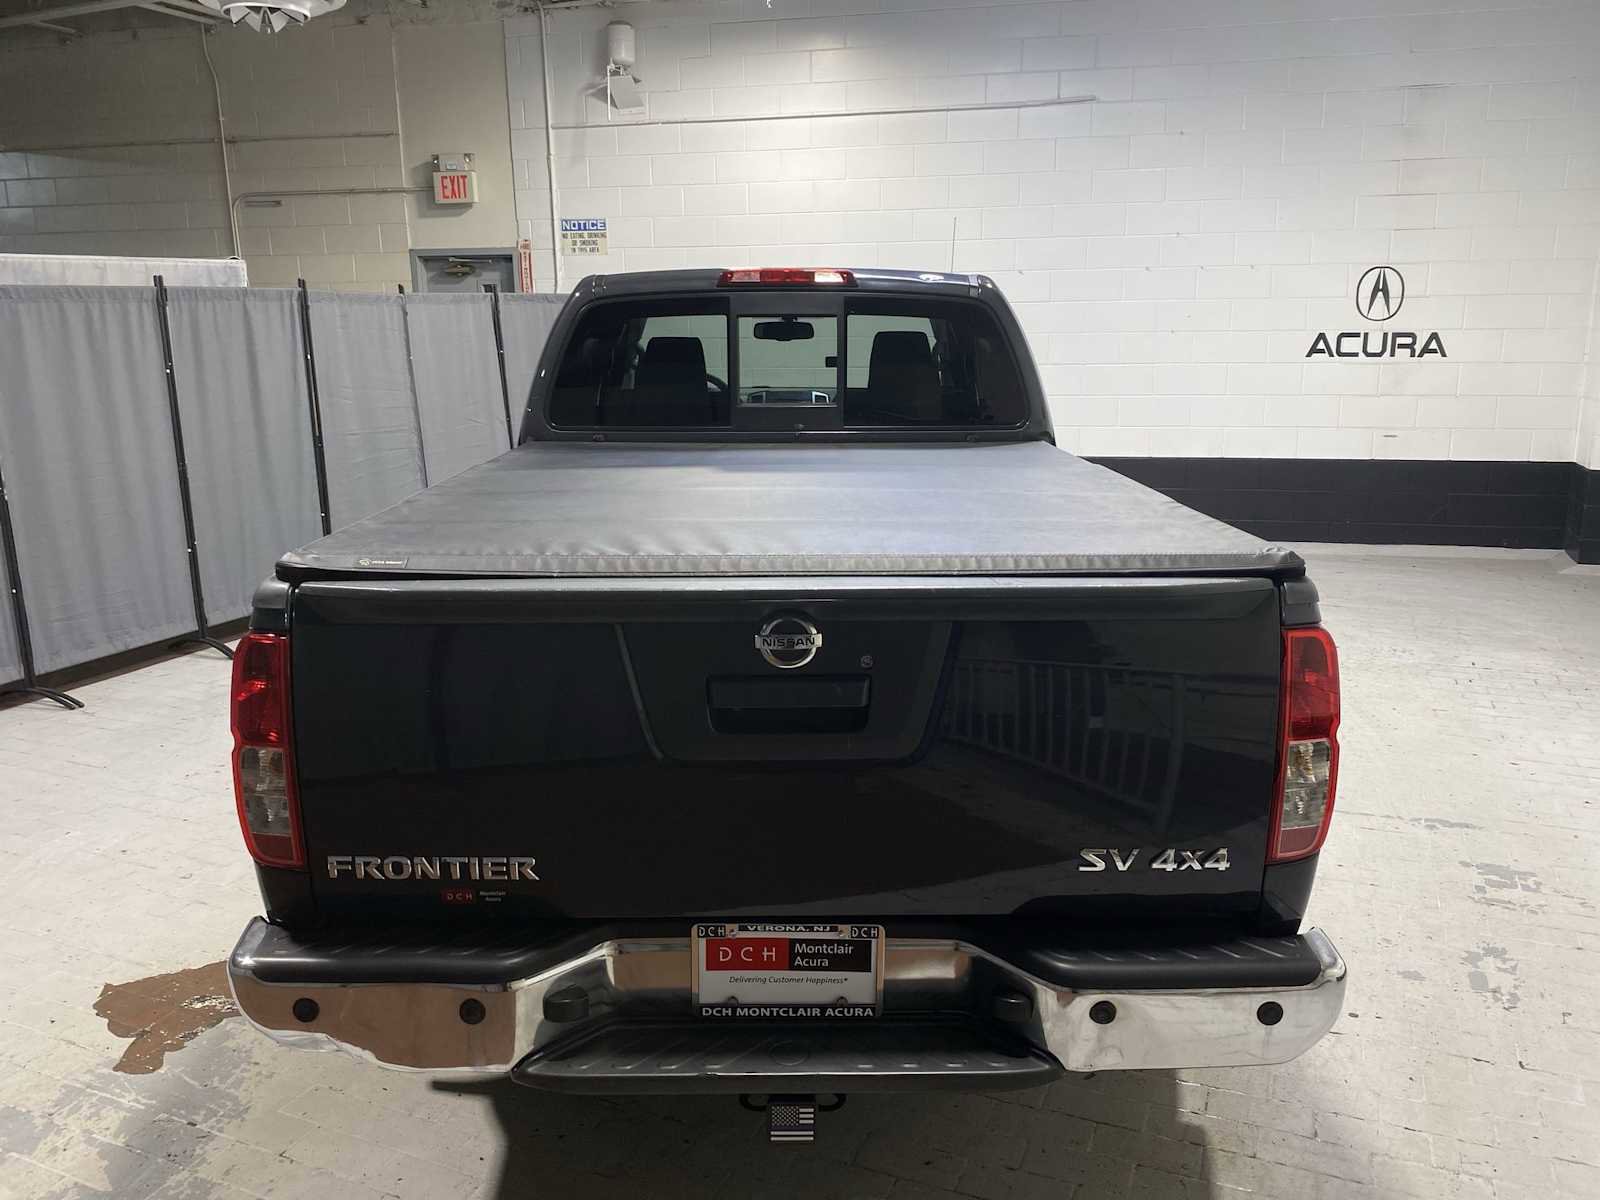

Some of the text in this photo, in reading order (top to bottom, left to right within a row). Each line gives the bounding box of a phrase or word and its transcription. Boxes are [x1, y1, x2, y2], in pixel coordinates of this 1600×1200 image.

[440, 175, 467, 199] EXIT
[562, 220, 606, 230] NOTICE
[1305, 332, 1447, 358] ACURA
[762, 636, 815, 648] NISSAN
[1079, 848, 1140, 871] SV
[327, 855, 540, 881] FRONTIER
[795, 943, 854, 954] Montclair
[794, 956, 829, 967] Acura
[728, 975, 767, 985] Delivering
[768, 976, 804, 984] Customer
[702, 1007, 874, 1017] DCH MONTCLAIR ACURA
